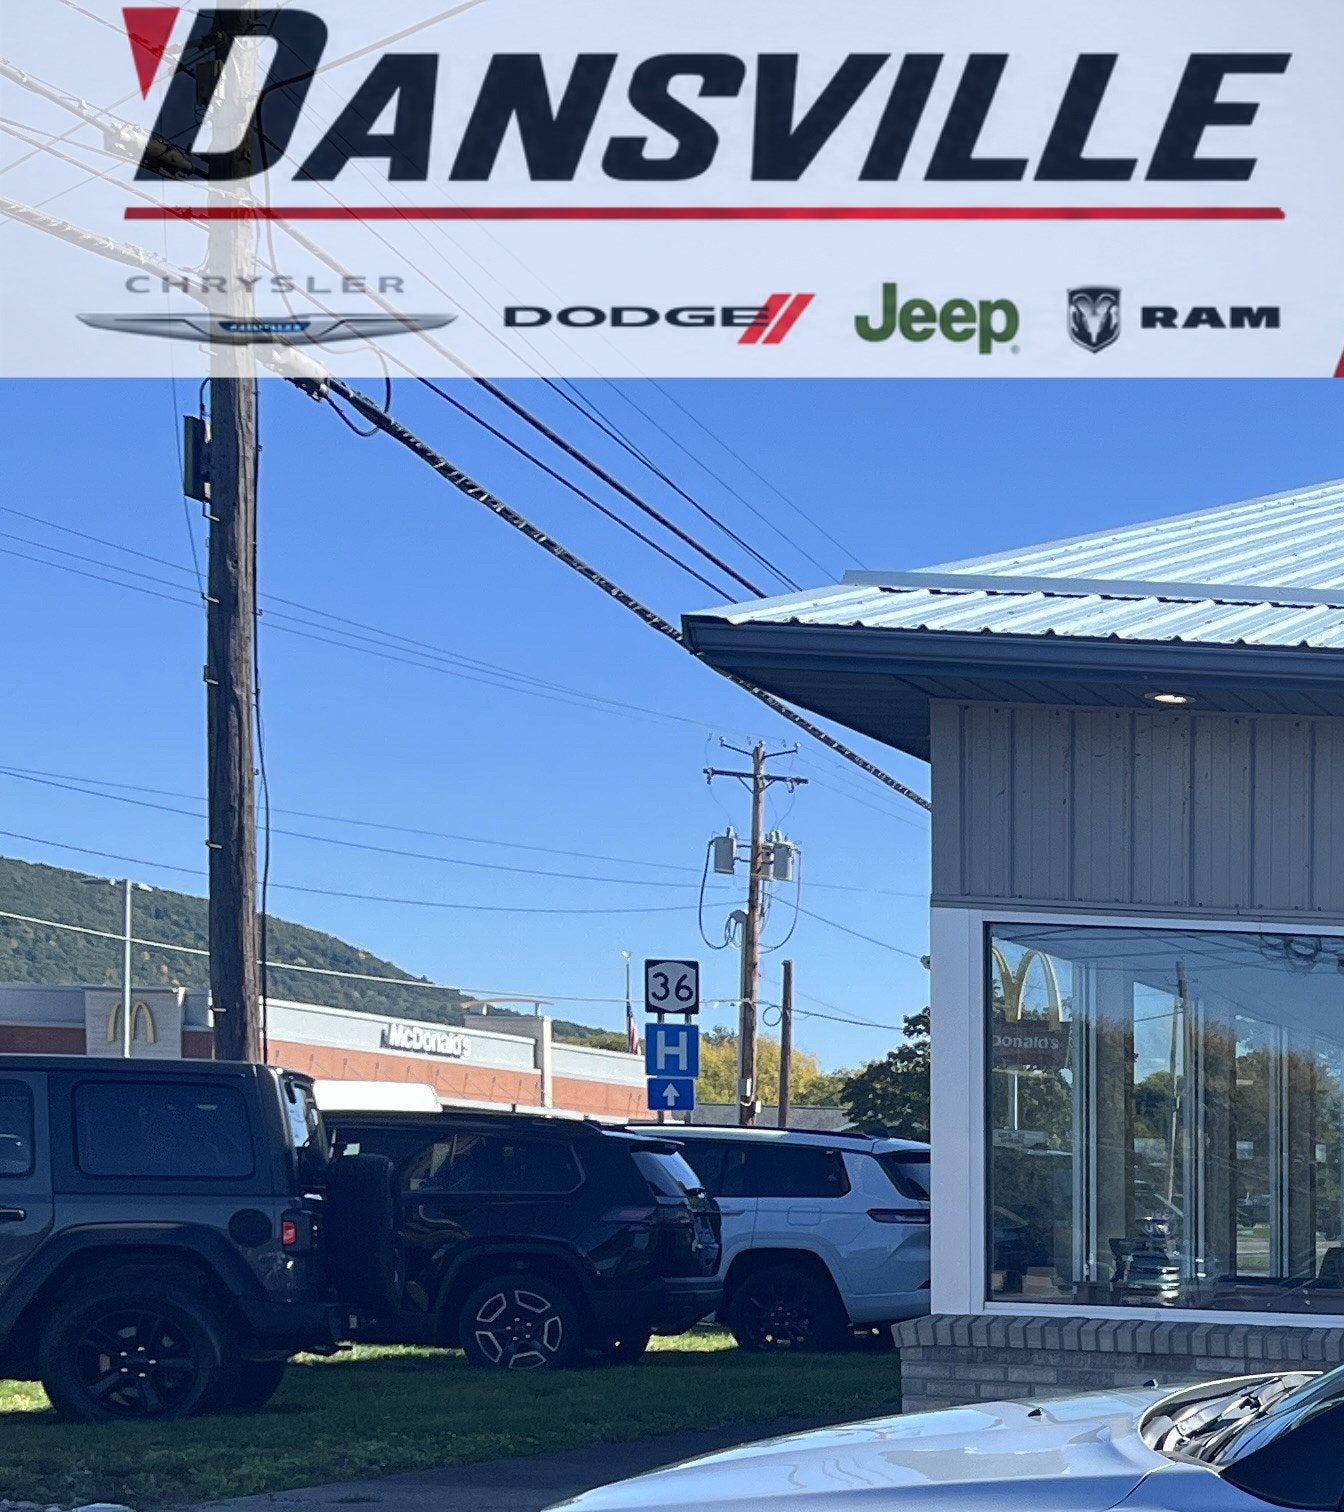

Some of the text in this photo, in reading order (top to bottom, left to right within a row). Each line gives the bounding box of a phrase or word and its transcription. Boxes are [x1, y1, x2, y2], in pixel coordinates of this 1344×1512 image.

[651, 972, 693, 1001] 36
[388, 1022, 472, 1060] McDonald's
[656, 1030, 688, 1071] H
